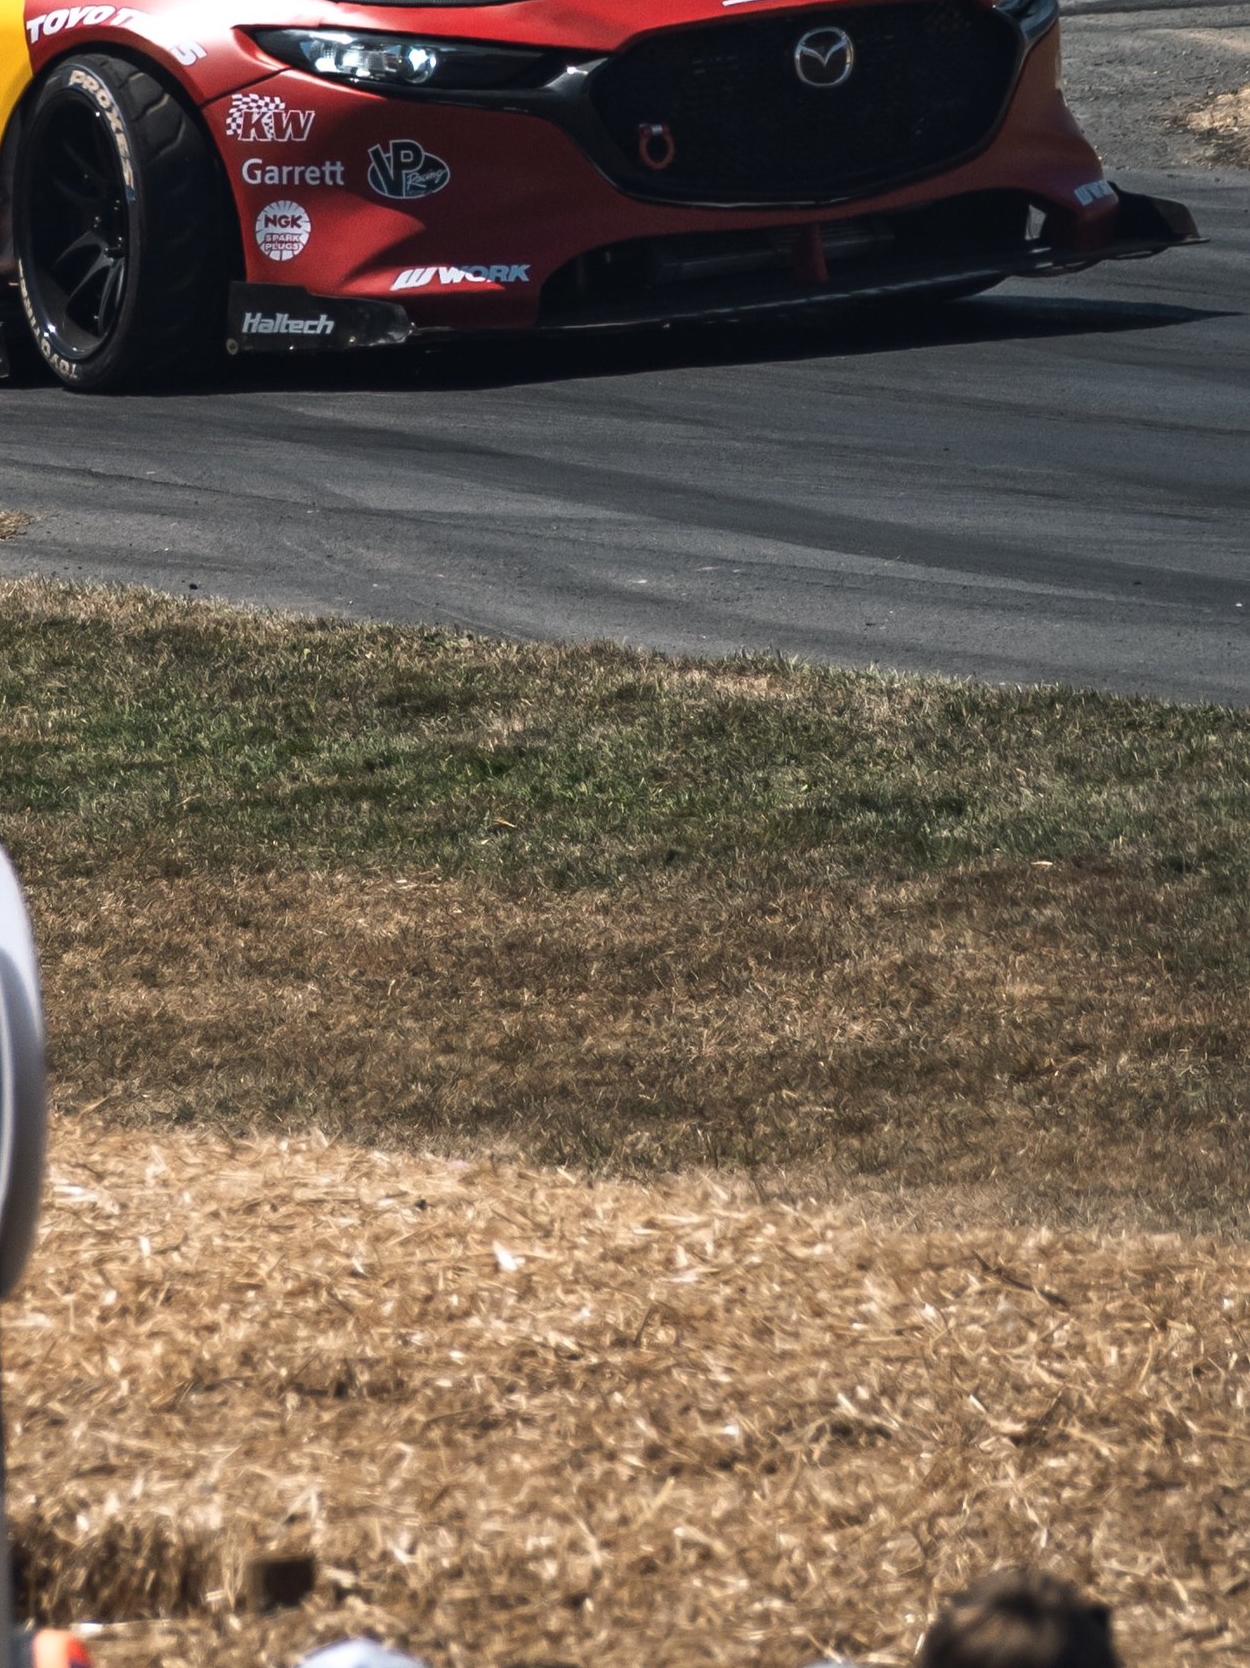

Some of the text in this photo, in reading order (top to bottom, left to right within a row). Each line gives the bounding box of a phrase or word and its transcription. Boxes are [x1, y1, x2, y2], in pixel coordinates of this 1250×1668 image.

[26, 5, 116, 45] TOYO
[237, 109, 316, 142] KW
[242, 157, 344, 185] Garrett
[367, 138, 425, 200] VP
[264, 214, 302, 228] NGK
[265, 234, 300, 242] SPARK
[438, 264, 532, 284] WORK
[242, 313, 334, 335] Haltech
